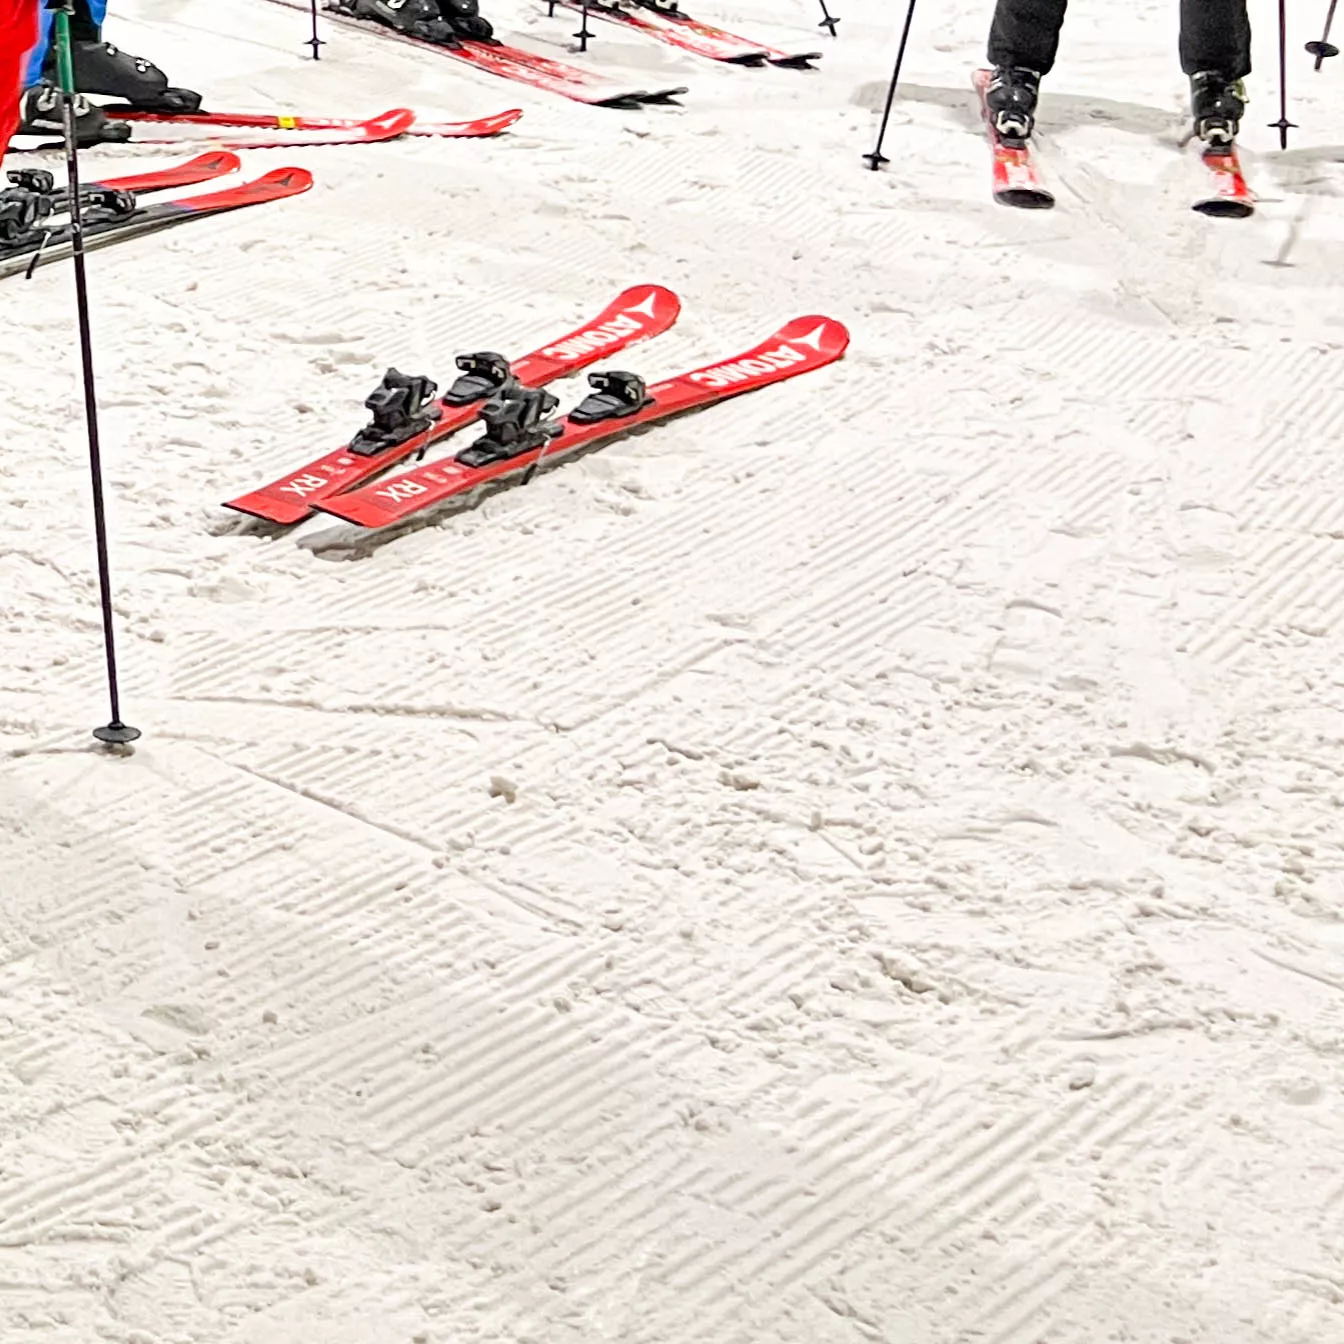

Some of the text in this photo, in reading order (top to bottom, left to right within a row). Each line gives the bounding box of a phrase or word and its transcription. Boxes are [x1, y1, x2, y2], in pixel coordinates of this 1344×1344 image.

[543, 313, 643, 360] ATOMIC
[690, 345, 807, 387] ATOMIC
[280, 474, 329, 498] RX
[376, 479, 429, 504] RX
